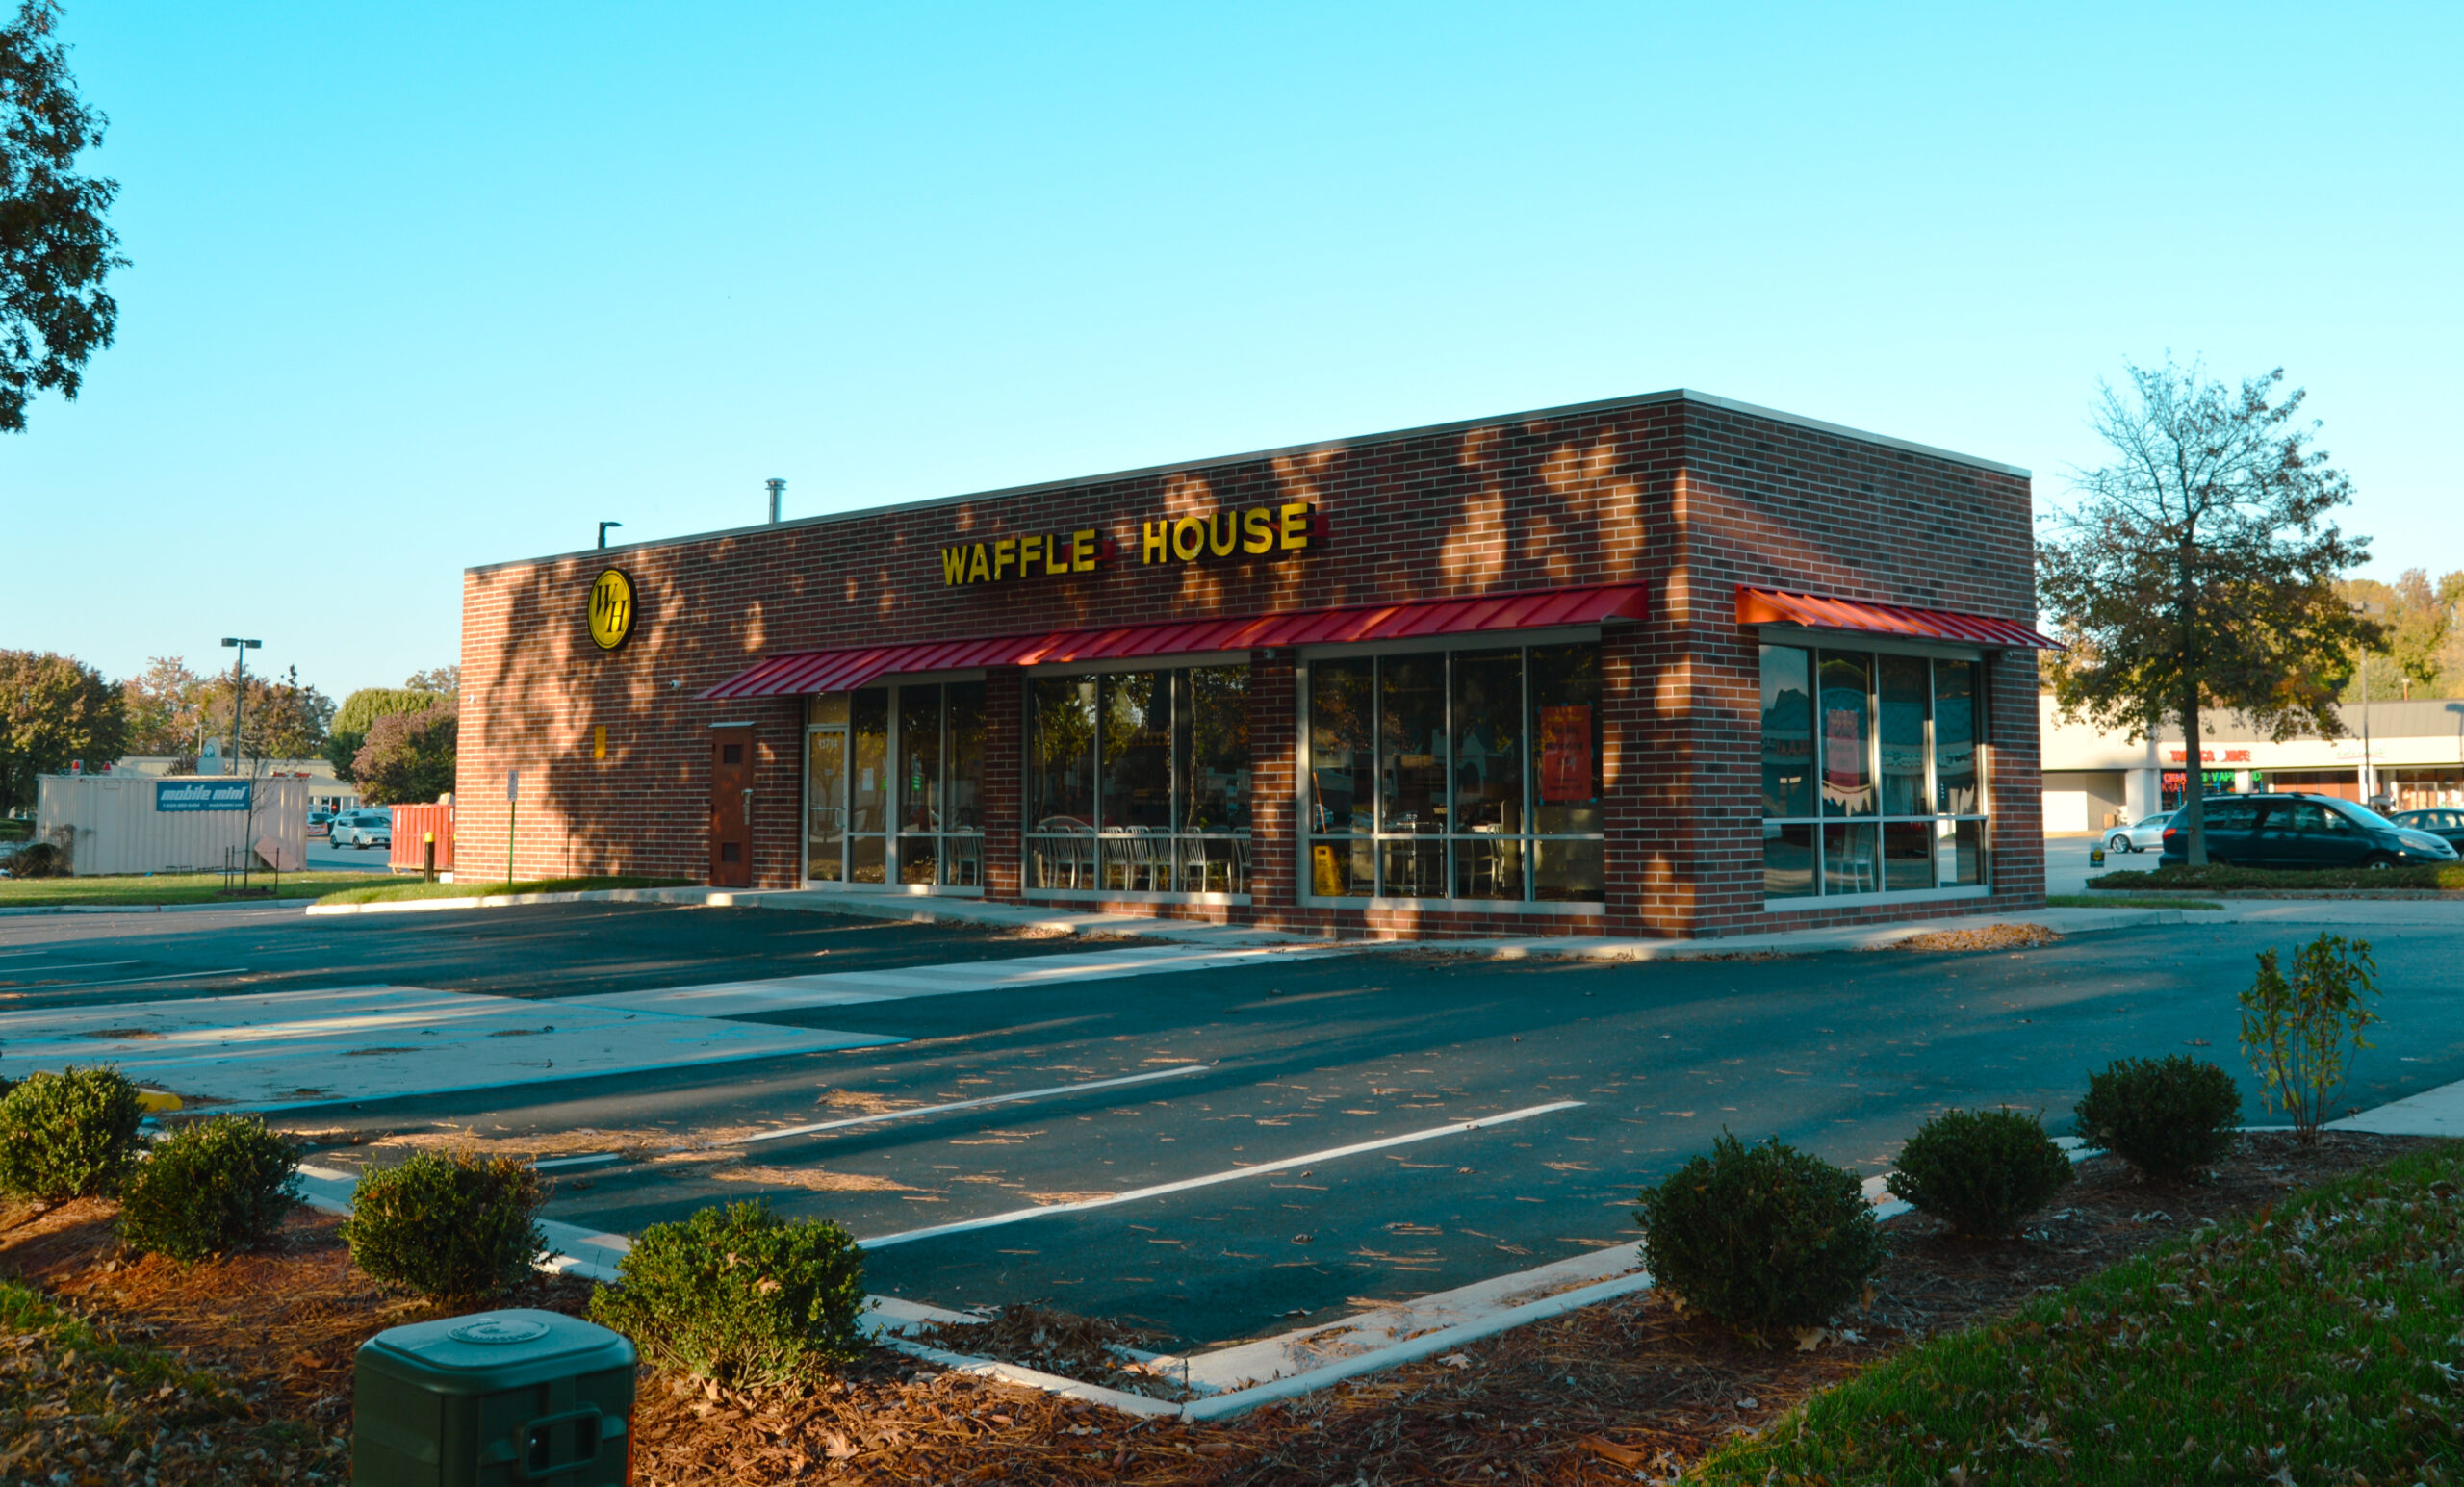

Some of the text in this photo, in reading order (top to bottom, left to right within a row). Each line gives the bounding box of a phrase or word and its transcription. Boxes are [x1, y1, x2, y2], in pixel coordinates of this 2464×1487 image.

[940, 502, 1309, 586] WAFFLE HOUSE
[161, 784, 247, 801] mobile mini
